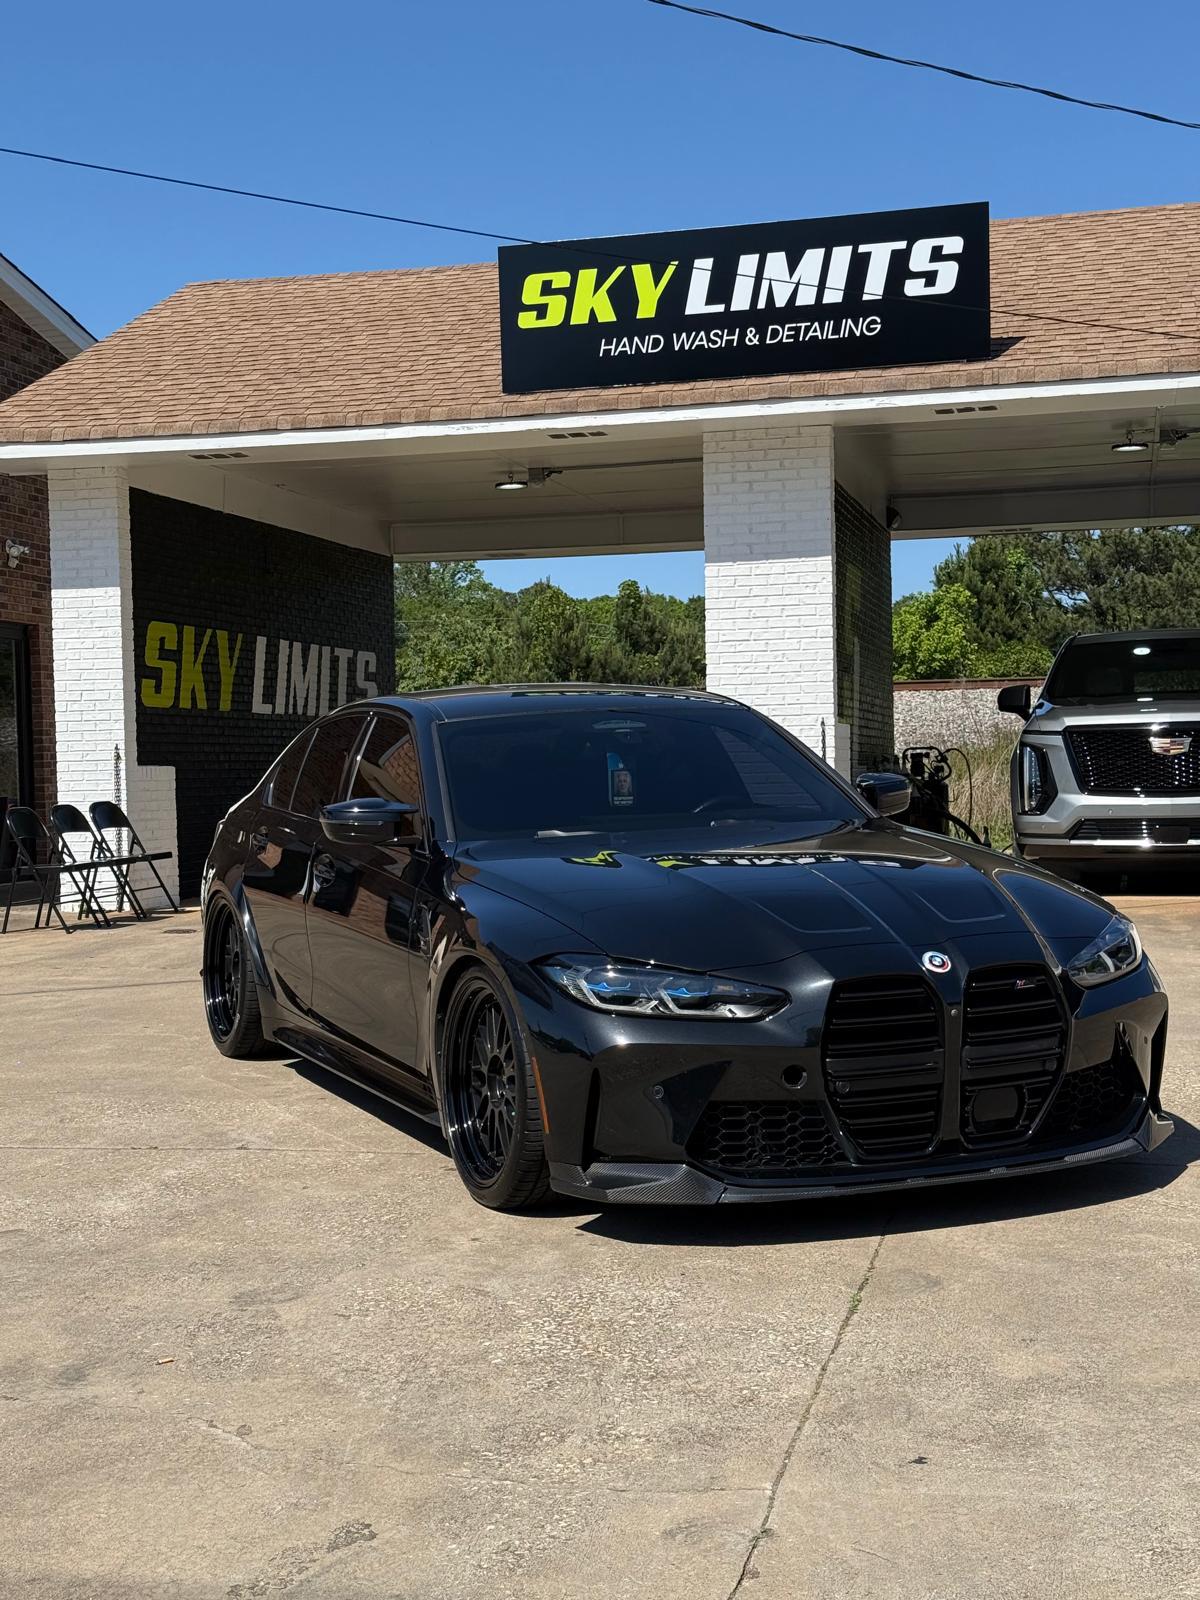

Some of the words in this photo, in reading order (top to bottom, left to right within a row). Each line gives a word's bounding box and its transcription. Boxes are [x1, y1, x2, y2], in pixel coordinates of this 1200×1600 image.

[517, 261, 679, 329] SKY
[684, 235, 965, 316] LIMITS
[599, 334, 664, 357] HAND
[672, 328, 740, 351] WASH
[744, 327, 760, 346] &
[765, 315, 882, 344] DETAILING
[140, 620, 244, 712] SKY
[251, 635, 378, 716] LIMITS
